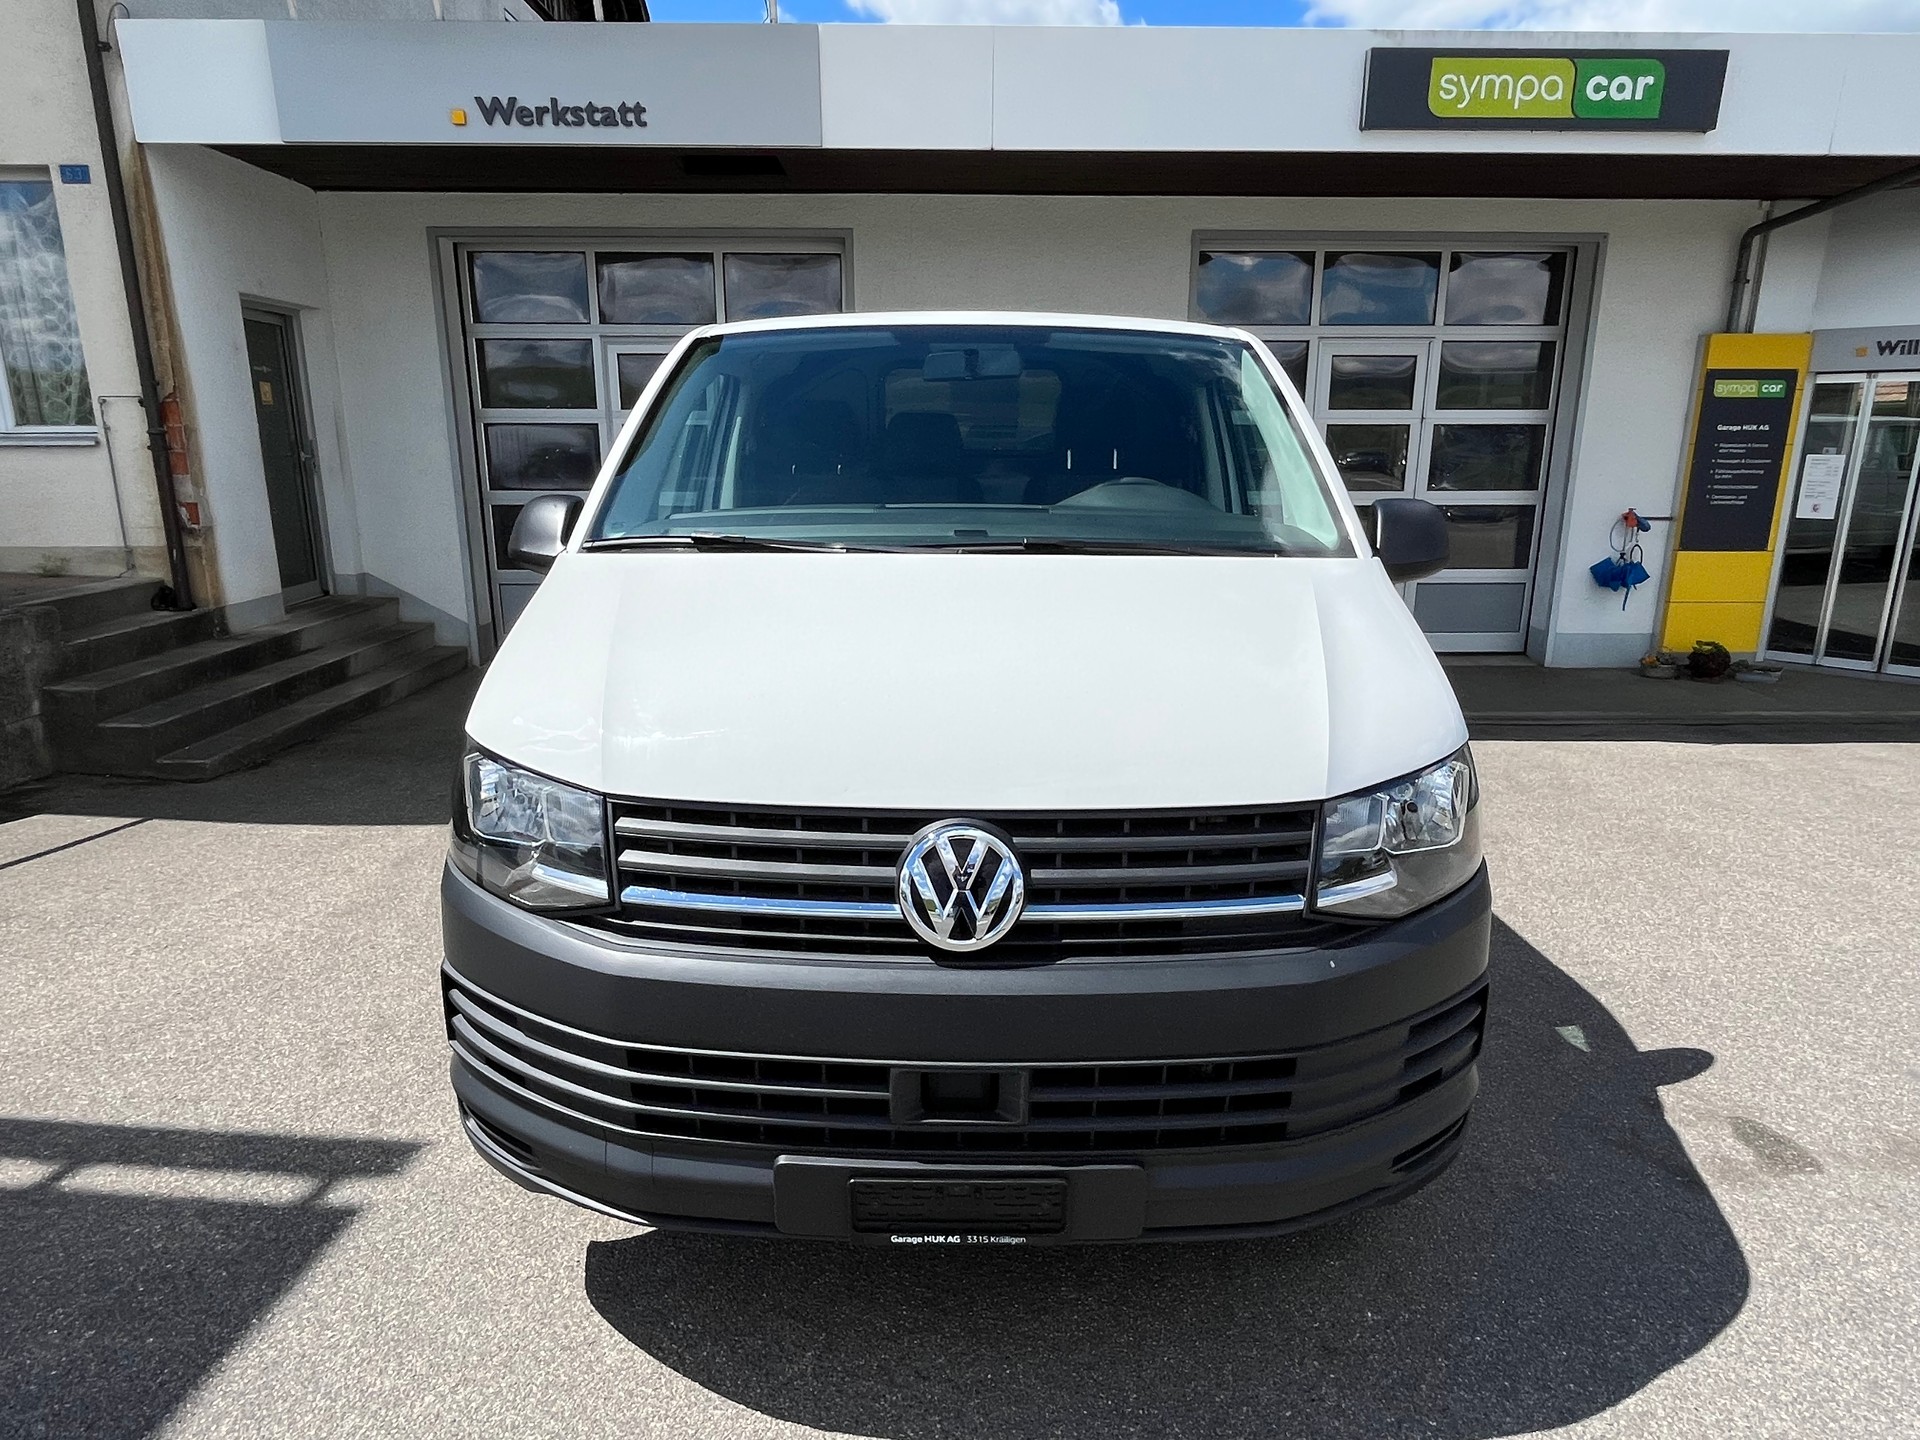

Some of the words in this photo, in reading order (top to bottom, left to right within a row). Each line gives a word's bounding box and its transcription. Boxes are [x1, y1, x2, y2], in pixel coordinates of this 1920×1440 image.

[1439, 74, 1563, 109] sympa
[1586, 75, 1654, 101] car
[474, 96, 647, 127] Werkstatt
[1876, 339, 1920, 356] Will
[1716, 384, 1756, 395] sympa
[1761, 384, 1783, 393] car
[1717, 424, 1741, 432] Garage
[890, 1235, 923, 1244] Garage
[924, 1235, 946, 1243] HUK
[946, 1235, 961, 1243] AG
[966, 1235, 989, 1243] 3315
